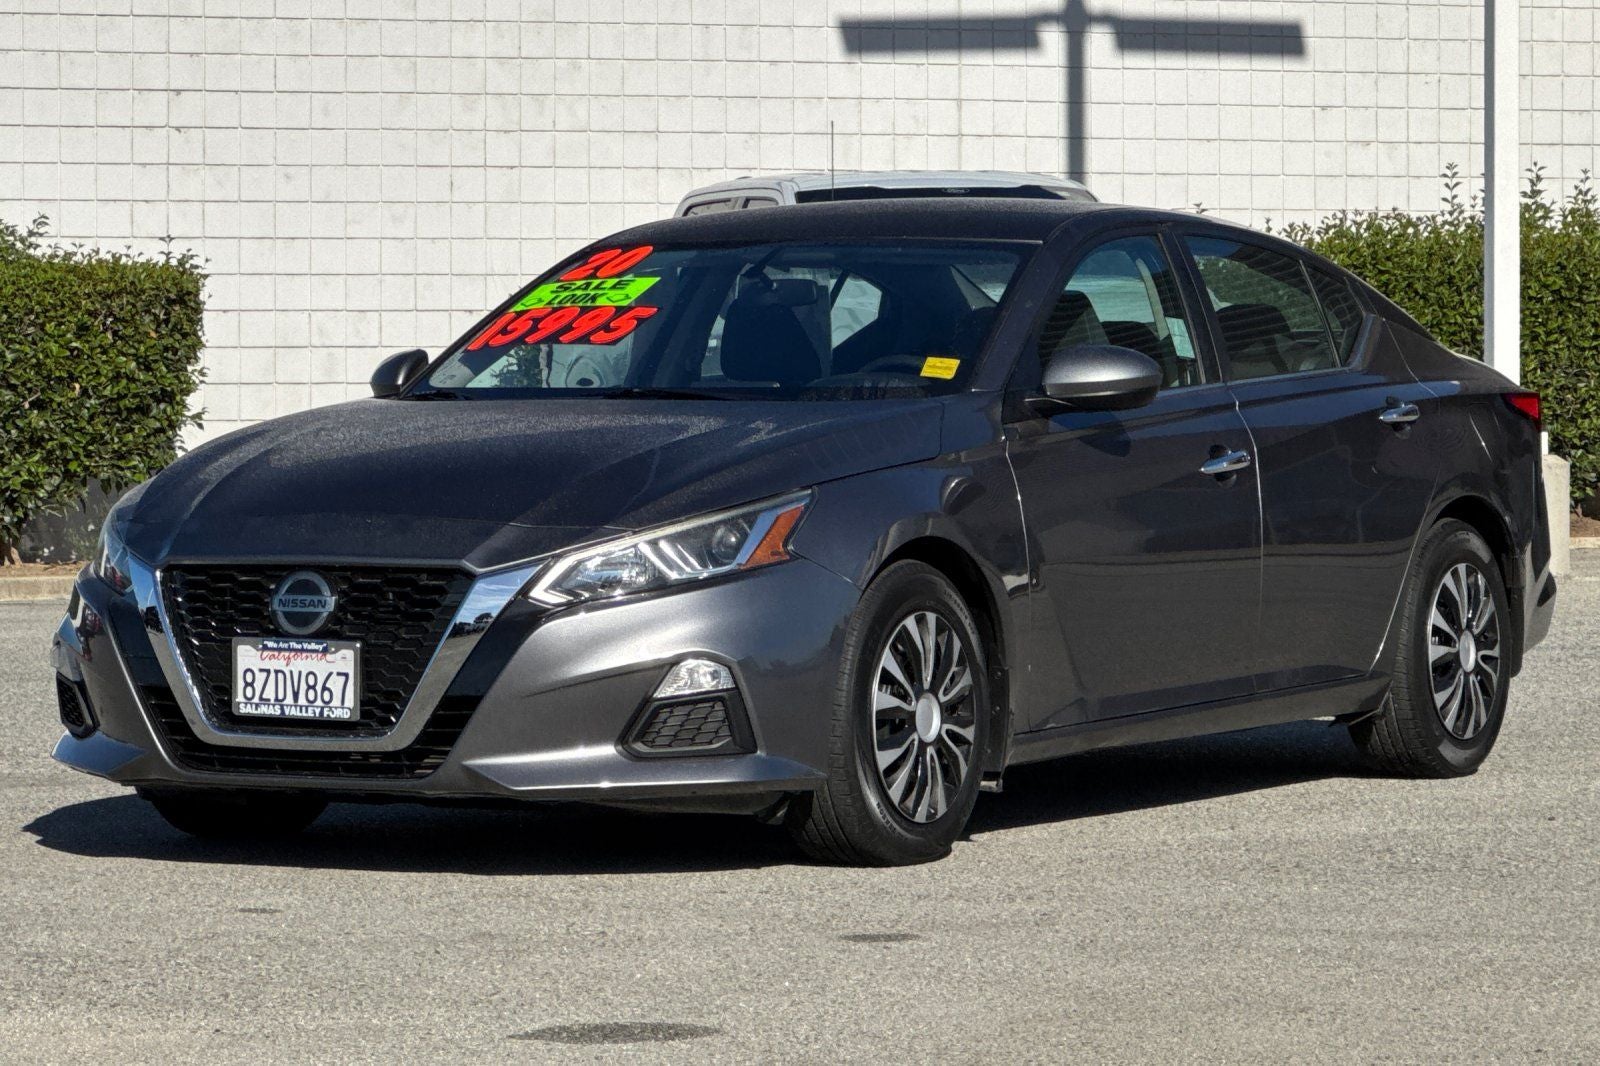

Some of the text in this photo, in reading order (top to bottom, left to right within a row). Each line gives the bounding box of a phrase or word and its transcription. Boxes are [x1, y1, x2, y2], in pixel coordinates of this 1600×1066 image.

[560, 245, 654, 281] 20
[550, 279, 636, 293] SALE
[545, 293, 609, 305] LOOK
[467, 306, 659, 351] 15995
[277, 598, 327, 609] NISSAN
[279, 641, 288, 649] Are
[289, 641, 301, 650] The
[260, 651, 336, 667] California
[242, 667, 350, 706] 8ZDV867
[239, 703, 351, 719] SALINAS VALLEY FORD
